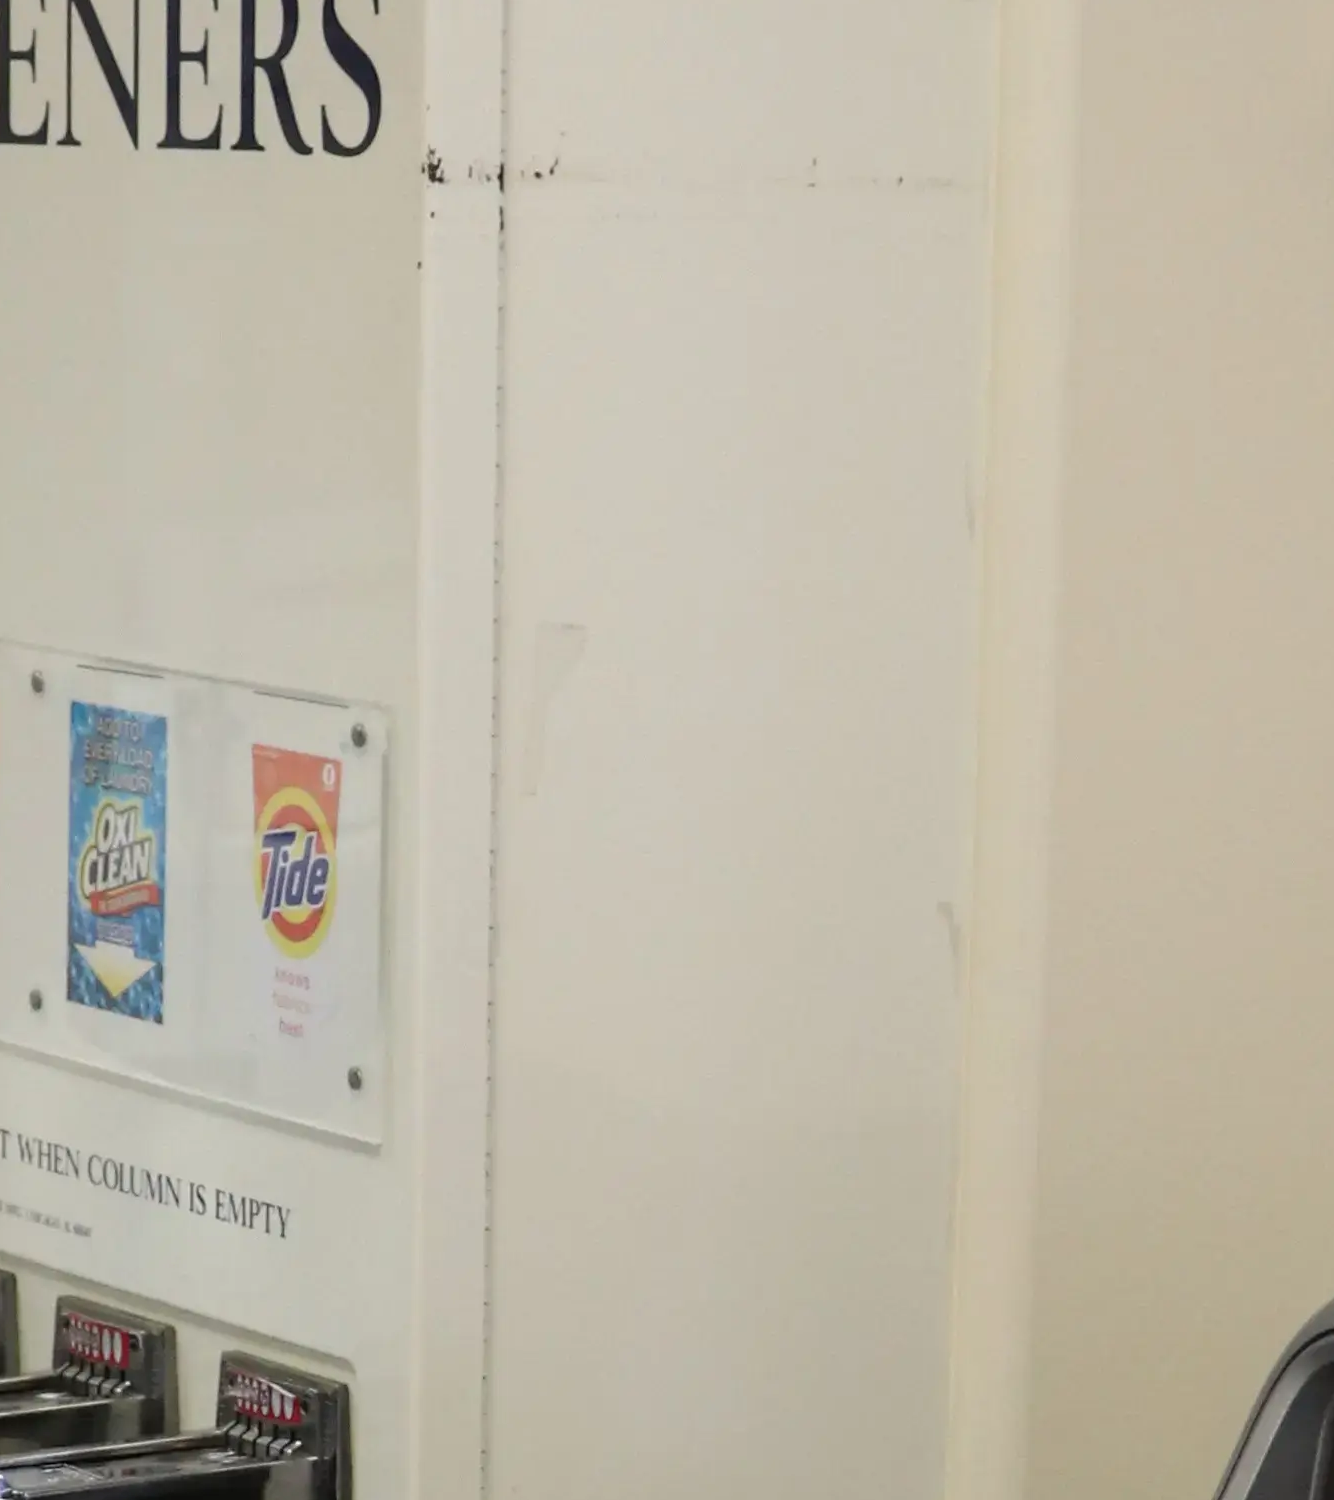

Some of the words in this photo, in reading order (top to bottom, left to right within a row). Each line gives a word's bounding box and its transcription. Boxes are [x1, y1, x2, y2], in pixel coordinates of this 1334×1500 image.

[96, 803, 138, 854] OXI
[81, 838, 153, 899] CLEAN
[261, 828, 330, 921] Tide
[17, 1134, 81, 1180] WHEN
[88, 1154, 181, 1209] COLUMN
[187, 1182, 208, 1216] IS
[214, 1189, 292, 1240] EMPTY
